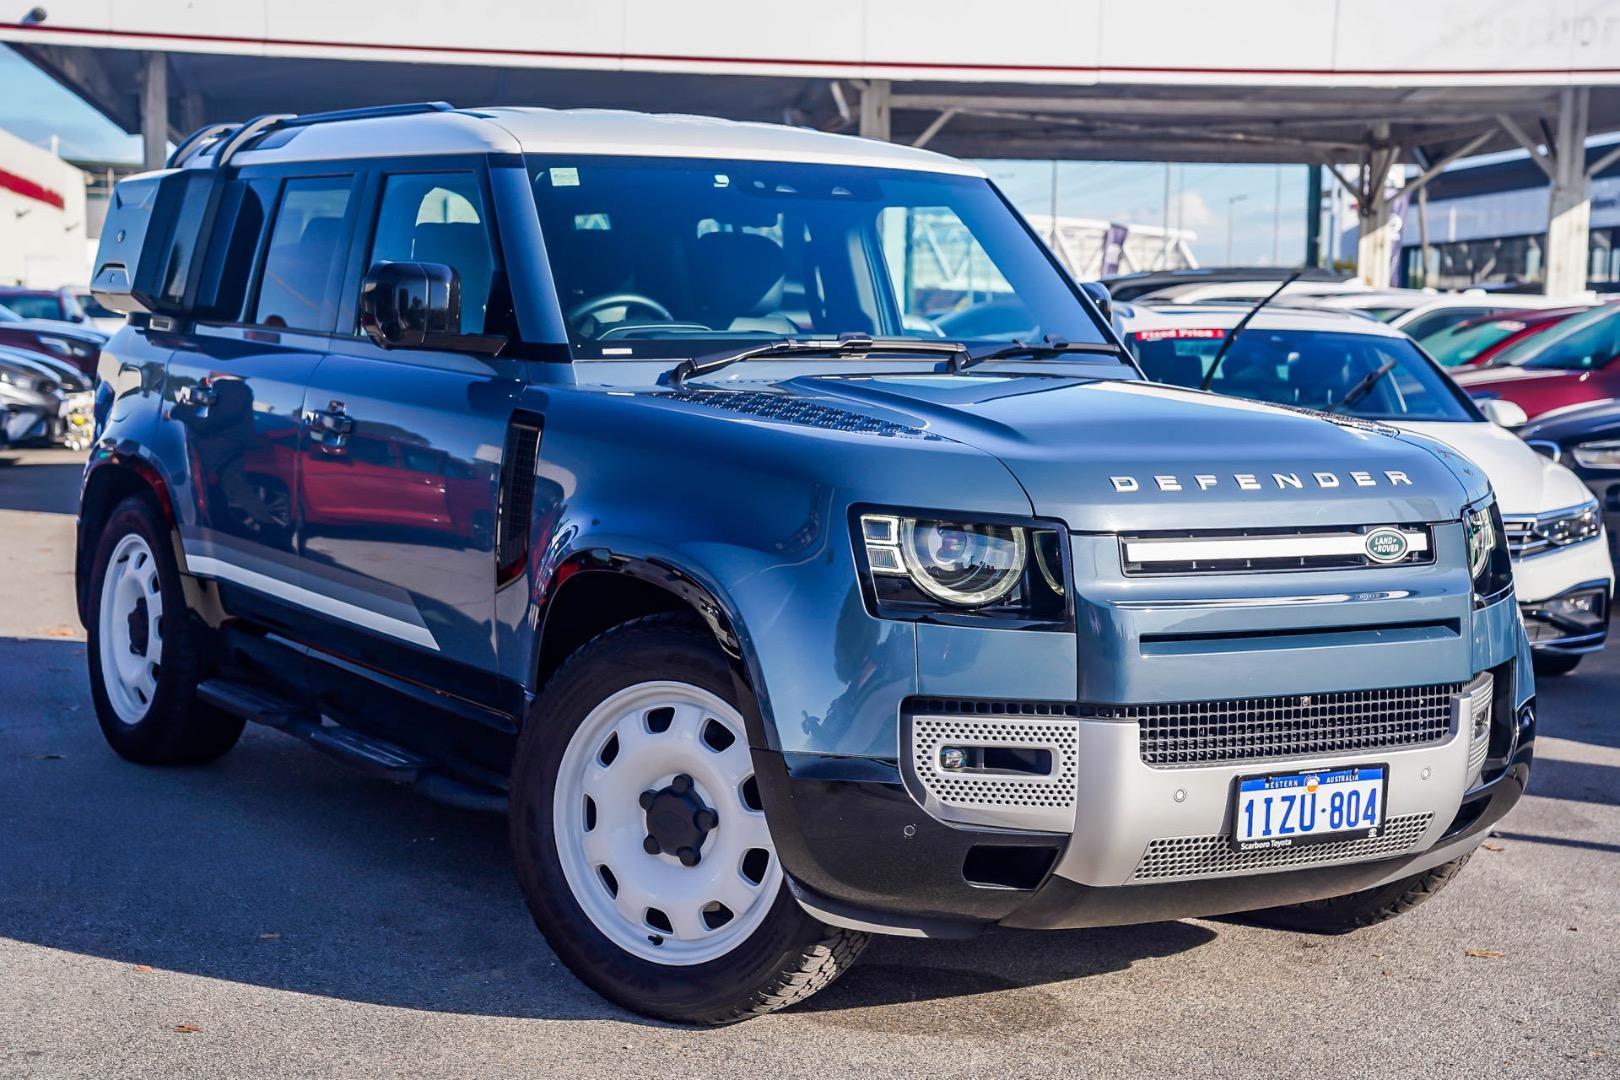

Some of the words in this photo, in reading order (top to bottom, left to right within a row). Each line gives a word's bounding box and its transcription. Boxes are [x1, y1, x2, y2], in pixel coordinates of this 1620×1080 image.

[1179, 329, 1213, 338] Price
[1109, 470, 1413, 493] DEFENDER
[1375, 536, 1393, 545] LAND
[1377, 543, 1399, 553] ROVER
[1264, 780, 1299, 789] WESTERN
[1326, 774, 1359, 784] AUSTRALIA
[1241, 841, 1270, 850] Scarboro
[1270, 839, 1292, 848] Toyota
